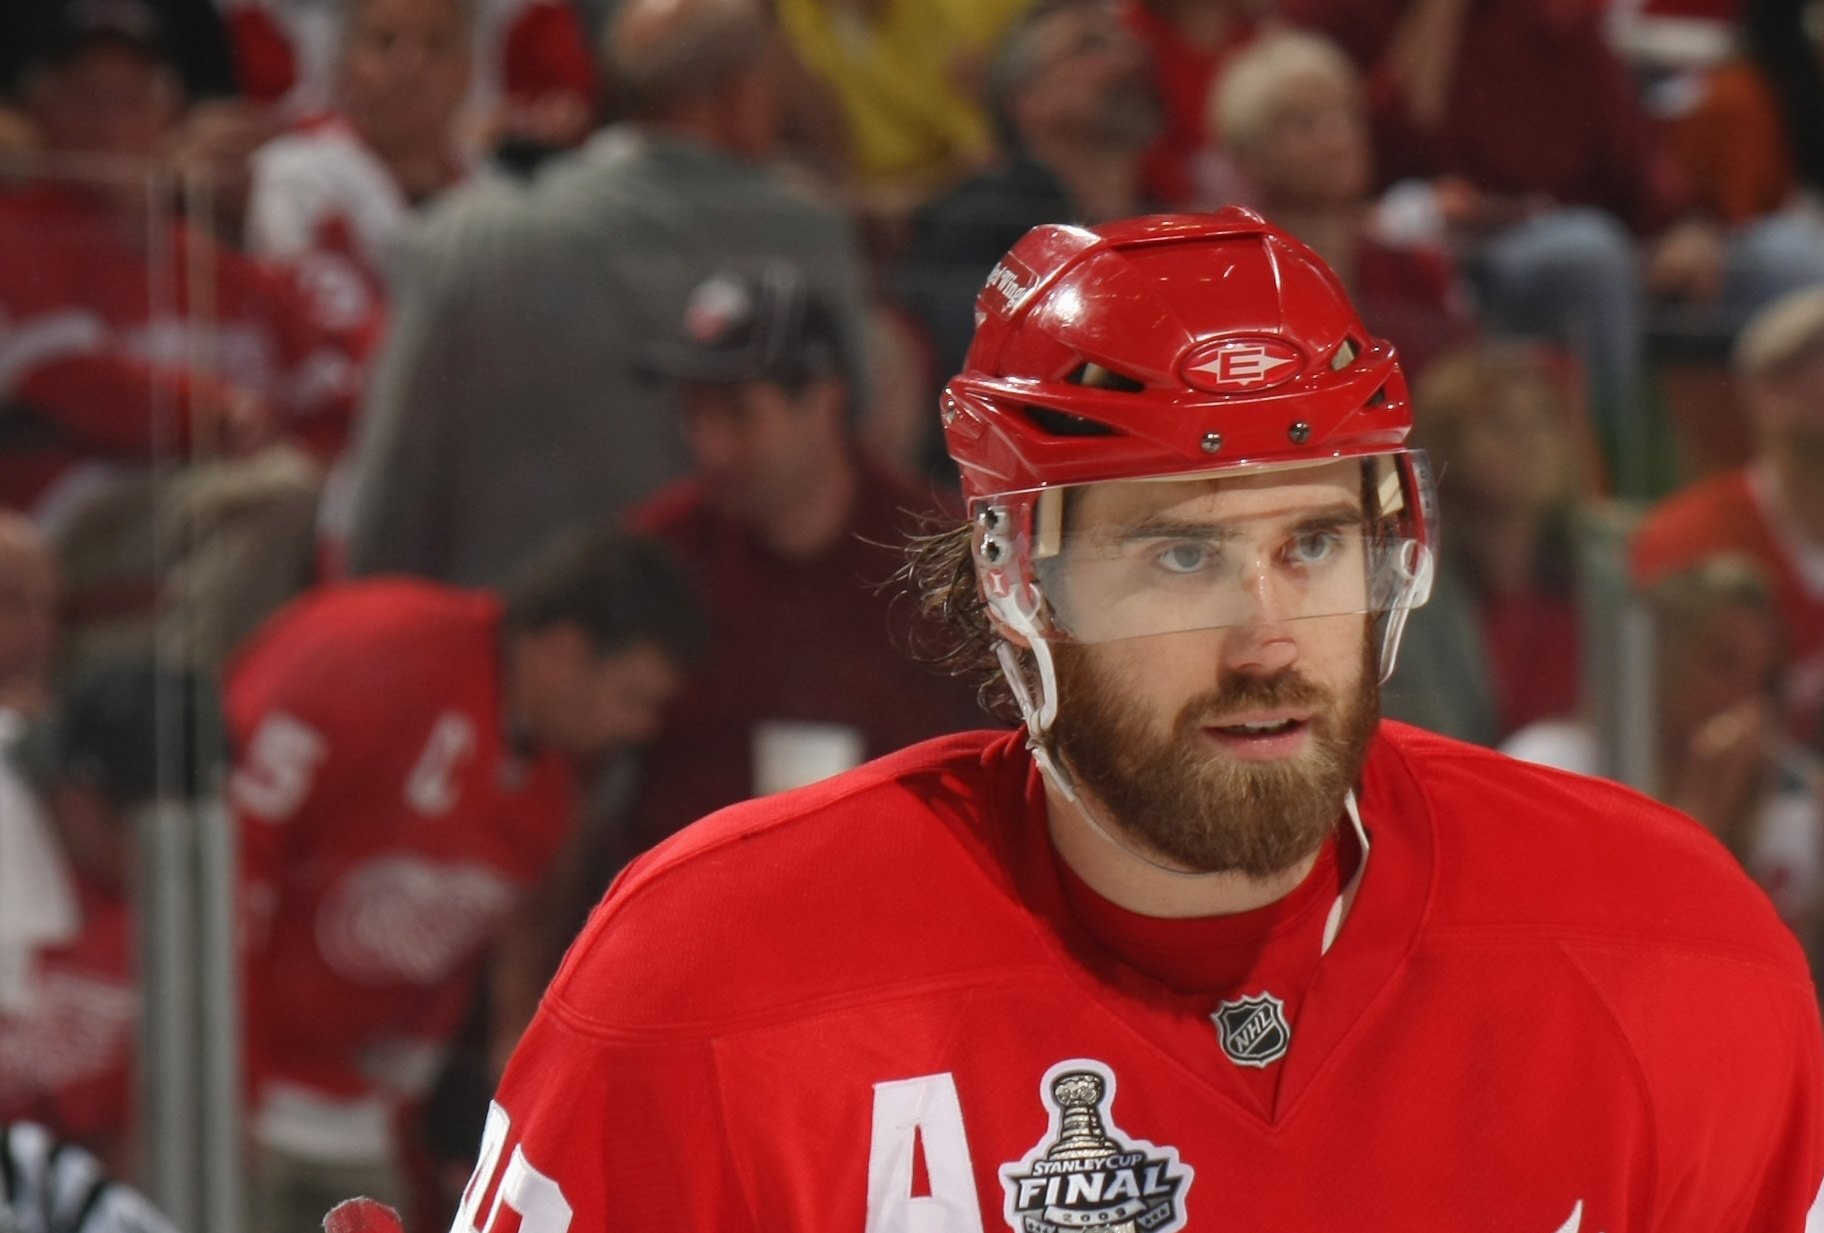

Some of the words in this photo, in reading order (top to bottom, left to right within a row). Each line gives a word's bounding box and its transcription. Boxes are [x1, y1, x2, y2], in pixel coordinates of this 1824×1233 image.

[1234, 1010, 1273, 1053] NHL
[1032, 1157, 1106, 1176] STANLEY
[1106, 1153, 1144, 1169] CUP
[1018, 1164, 1172, 1209] FINAL
[1062, 1206, 1127, 1223] 2009
